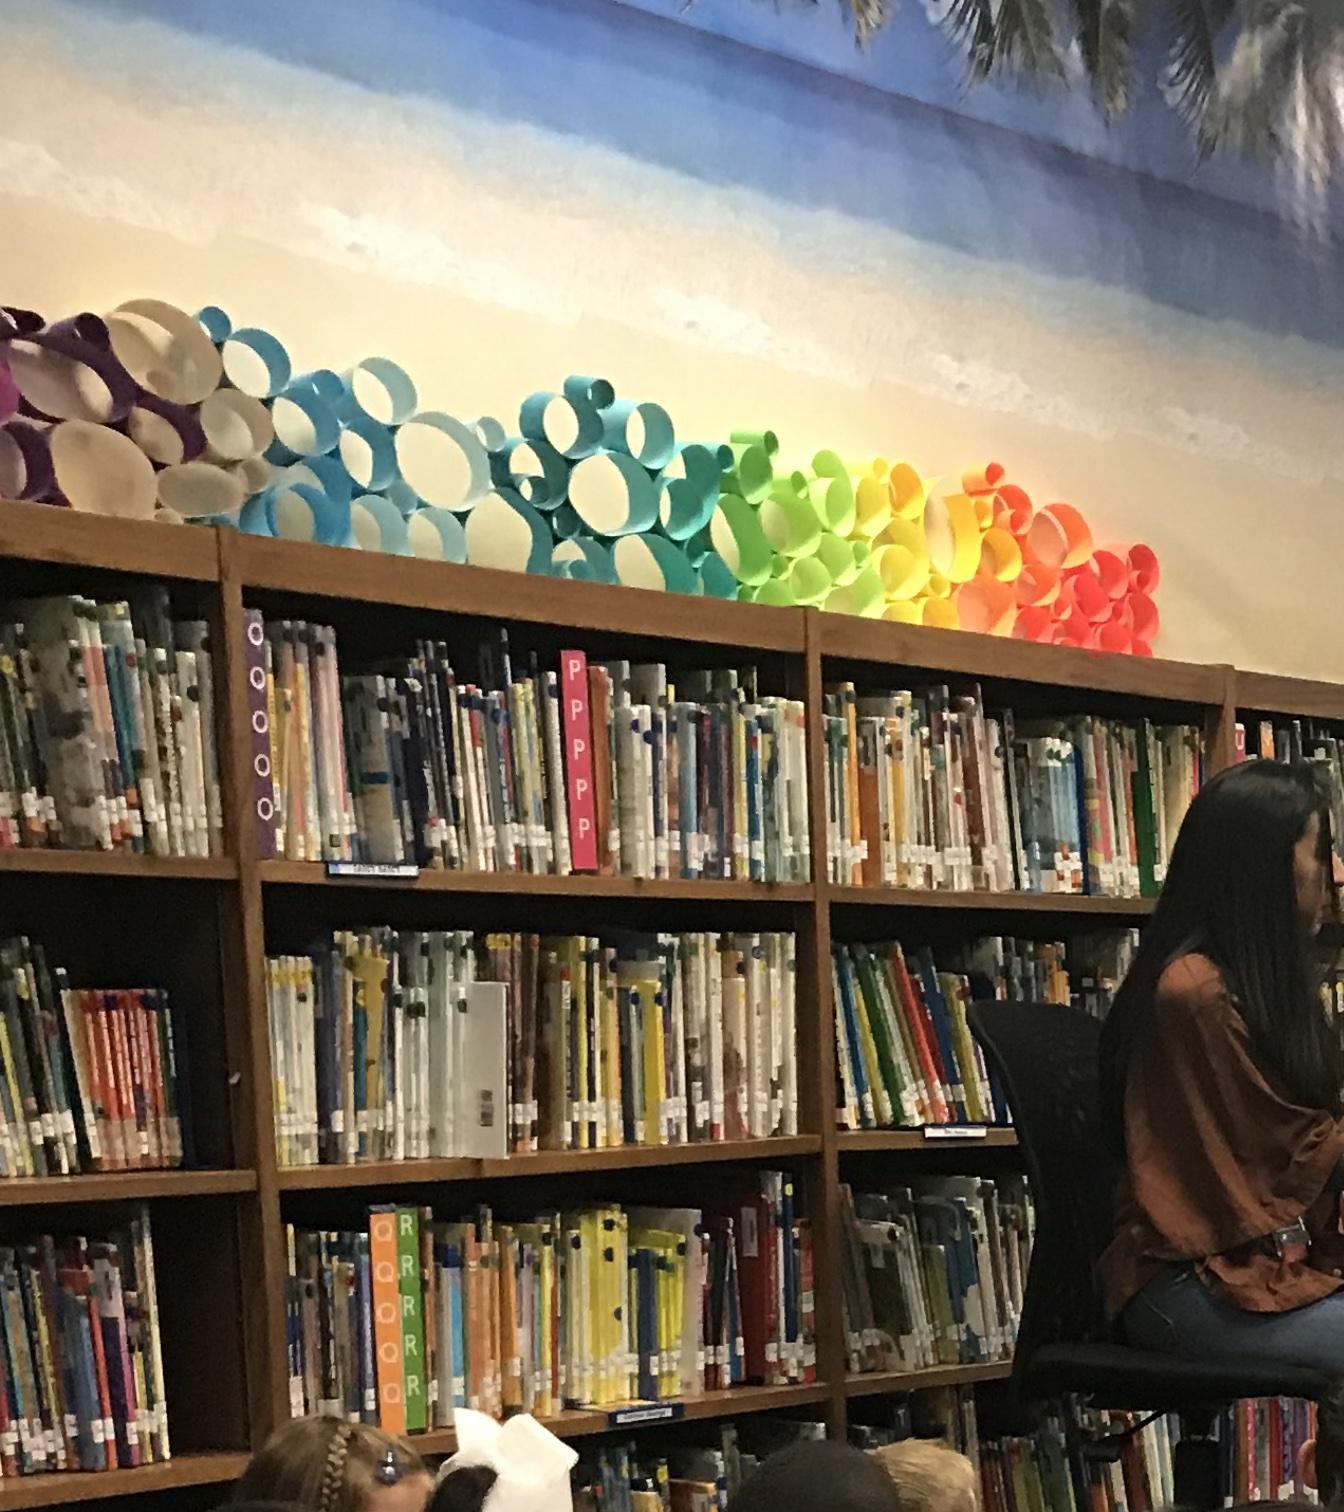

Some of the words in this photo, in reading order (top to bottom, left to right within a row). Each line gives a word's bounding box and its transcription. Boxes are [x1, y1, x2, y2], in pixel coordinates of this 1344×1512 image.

[569, 659, 580, 680] P
[572, 699, 583, 721] P
[574, 738, 585, 760] P
[576, 779, 588, 800] P
[578, 818, 590, 839] P
[400, 1214, 413, 1236] R
[401, 1254, 414, 1276] R
[403, 1295, 415, 1316] R
[405, 1334, 417, 1356] R
[407, 1375, 421, 1397] R
